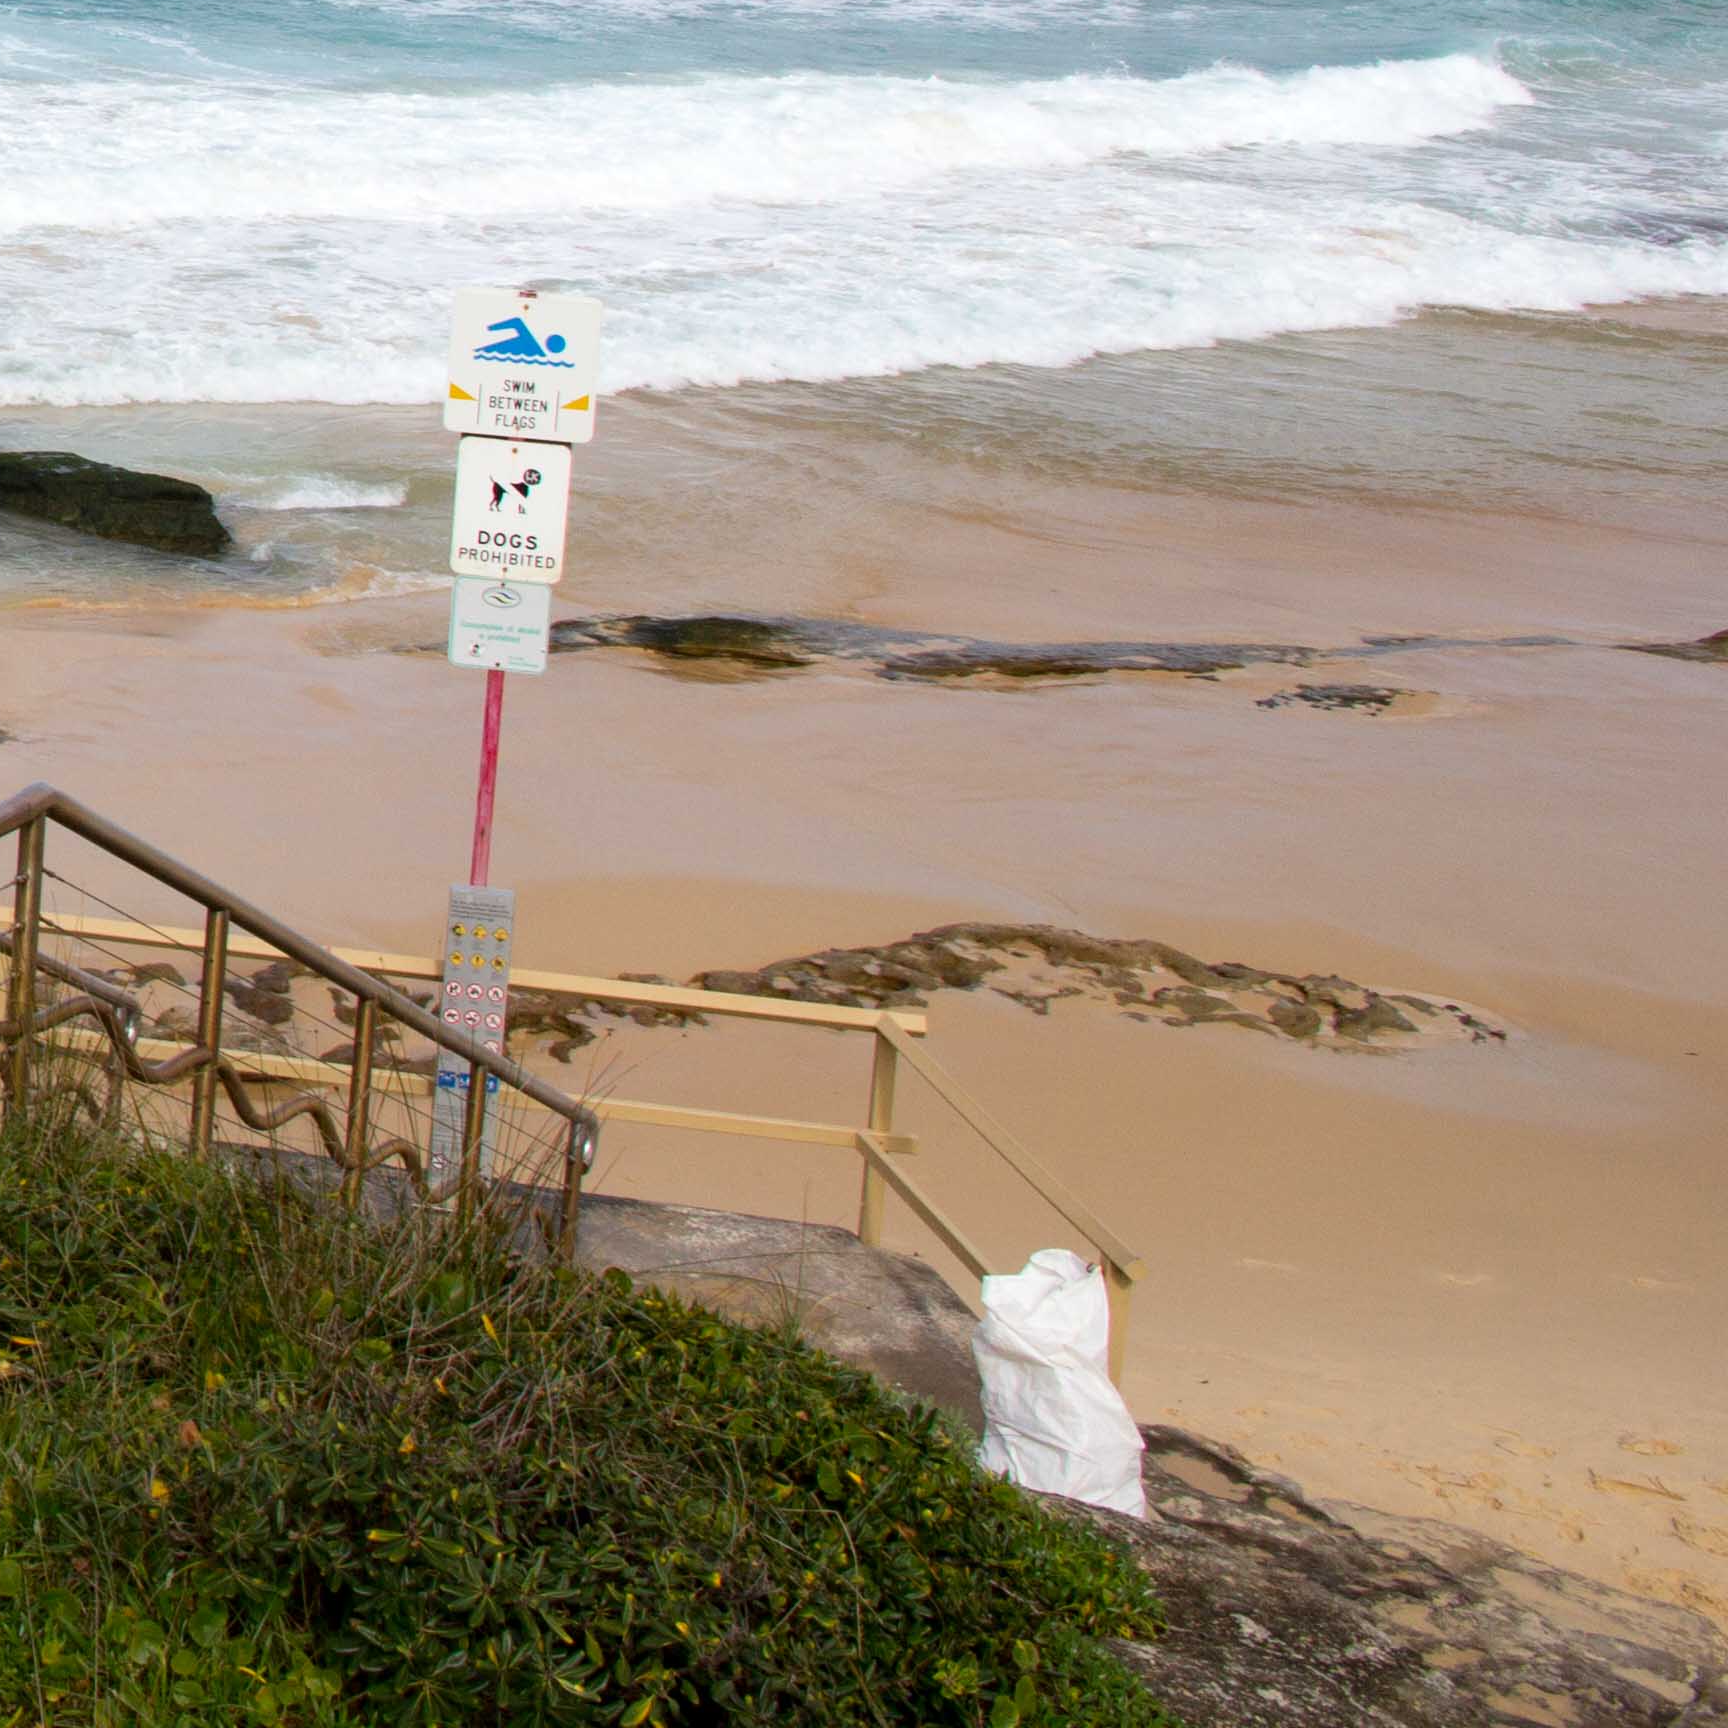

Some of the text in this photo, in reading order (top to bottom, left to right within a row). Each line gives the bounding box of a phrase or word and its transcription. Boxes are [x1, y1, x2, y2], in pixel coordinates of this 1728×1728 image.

[504, 379, 535, 394] SWIM
[489, 395, 548, 413] BETWEEN
[495, 414, 536, 429] FLAGS
[478, 530, 538, 550] DOGS
[458, 547, 556, 569] PROHIBITED
